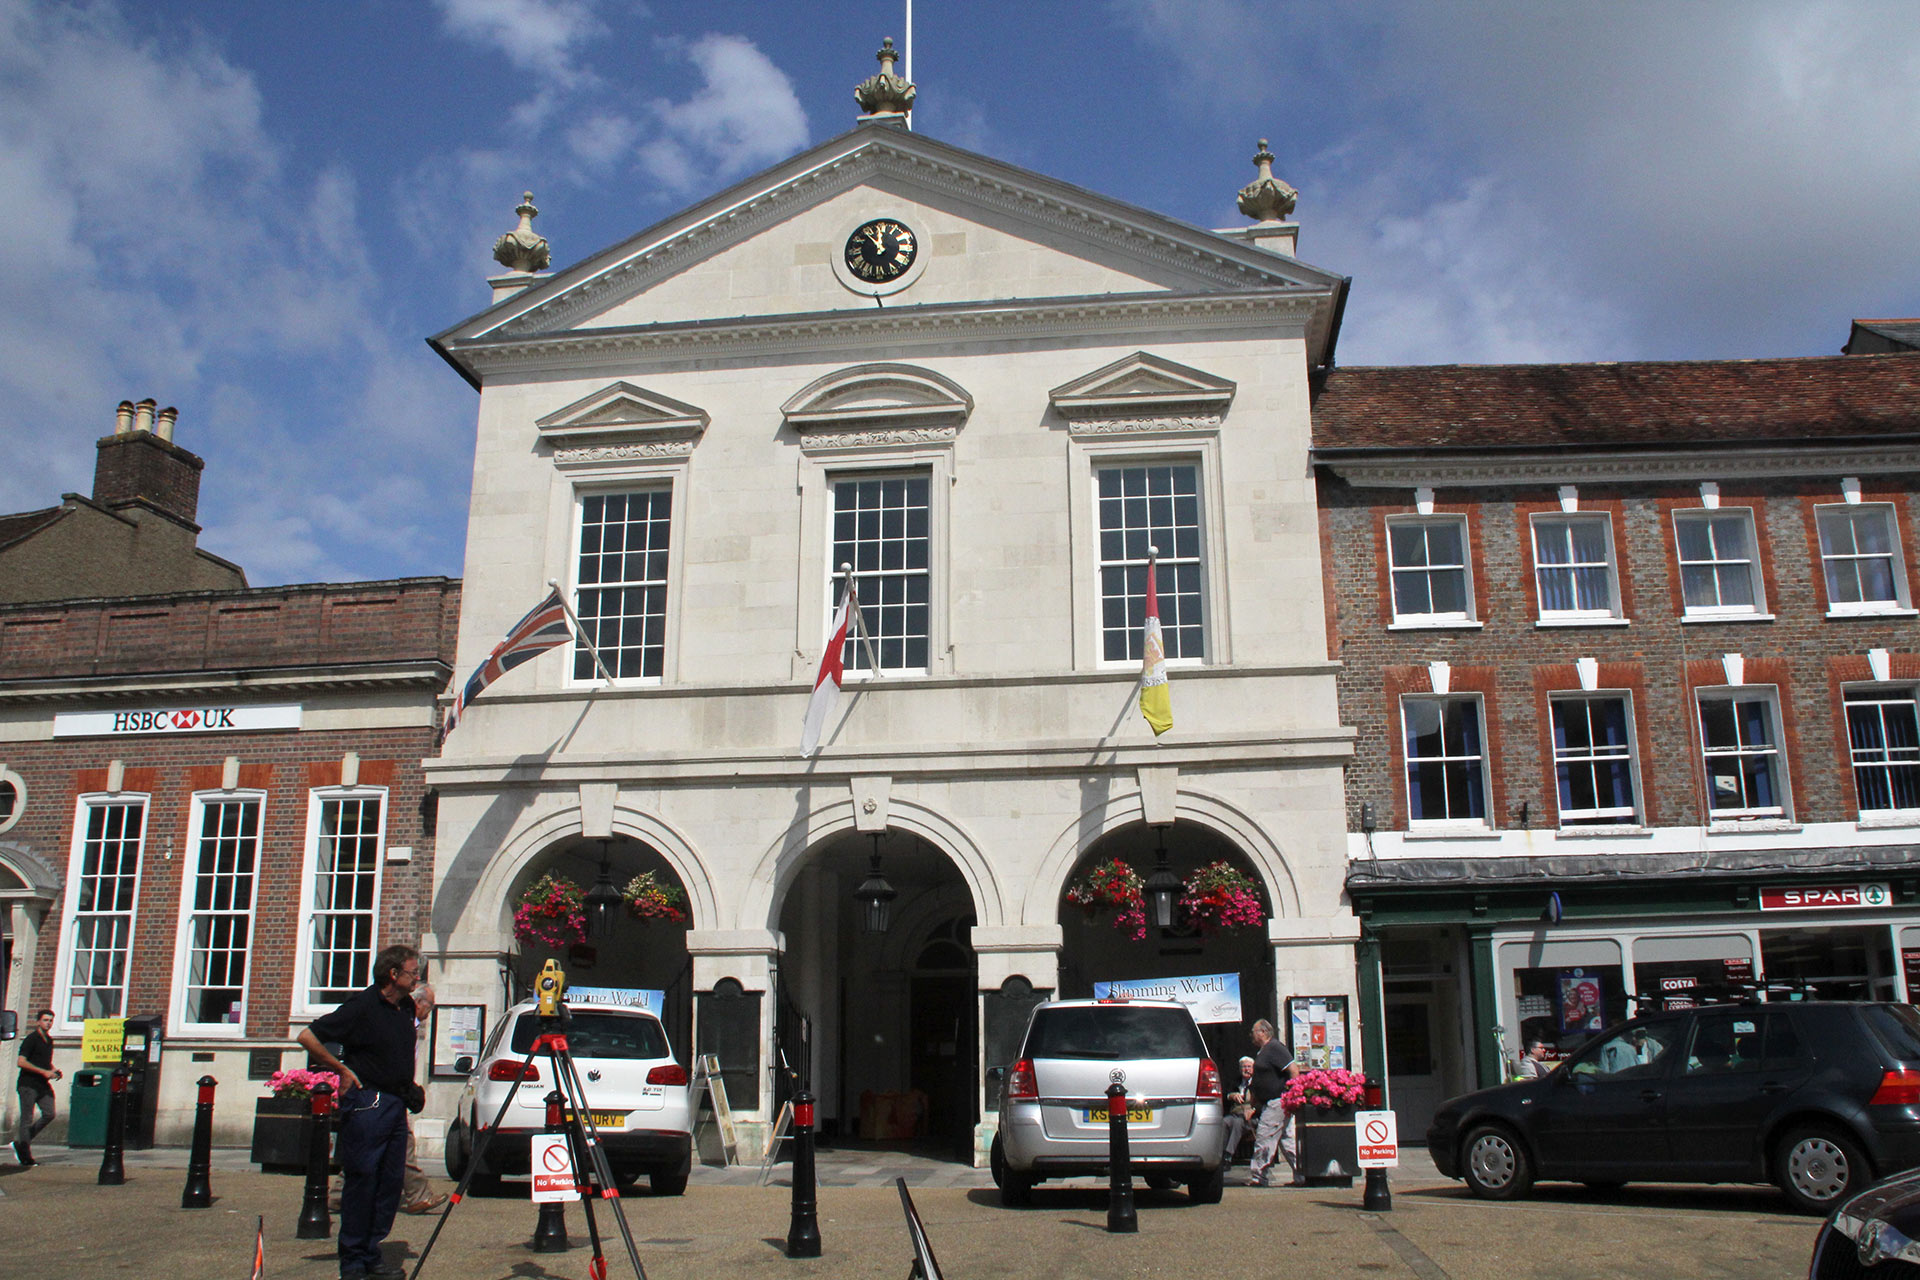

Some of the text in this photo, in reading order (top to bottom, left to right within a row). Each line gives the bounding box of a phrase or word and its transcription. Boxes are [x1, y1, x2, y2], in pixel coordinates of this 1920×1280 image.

[113, 709, 235, 731] HSBC UK
[1784, 889, 1859, 904] SPAR
[1109, 977, 1224, 999] Slimming World
[1663, 980, 1695, 990] COSTA
[611, 991, 649, 1006] World
[91, 1044, 121, 1052] MARK
[551, 1178, 575, 1186] Parking
